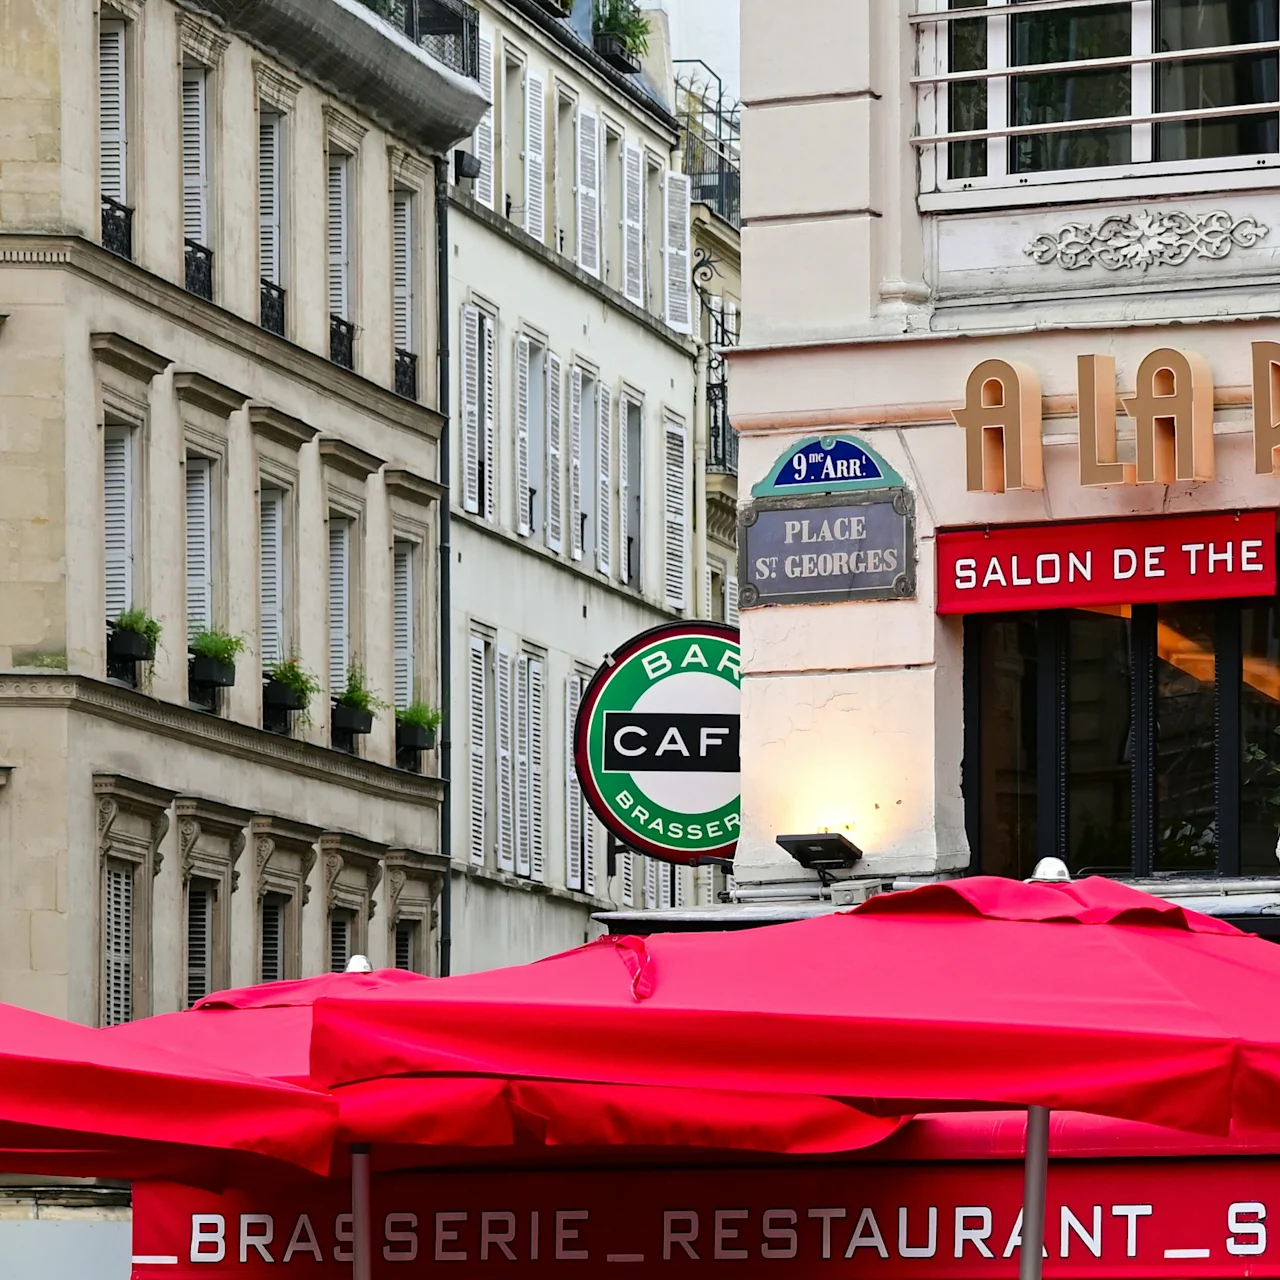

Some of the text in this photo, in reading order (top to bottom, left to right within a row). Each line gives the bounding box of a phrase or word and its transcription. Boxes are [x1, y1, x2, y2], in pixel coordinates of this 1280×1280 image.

[951, 358, 1042, 493] A
[1077, 348, 1214, 486] LA
[784, 516, 866, 544] PLACE
[785, 549, 897, 578] GEORGES
[954, 539, 1264, 589] SALON DE THE
[641, 644, 740, 681] BAR
[614, 725, 732, 757] CAF
[615, 790, 740, 839] BRASSER
[188, 1210, 589, 1263] BRASSERIE
[662, 1205, 1153, 1260] RESTAURANT
